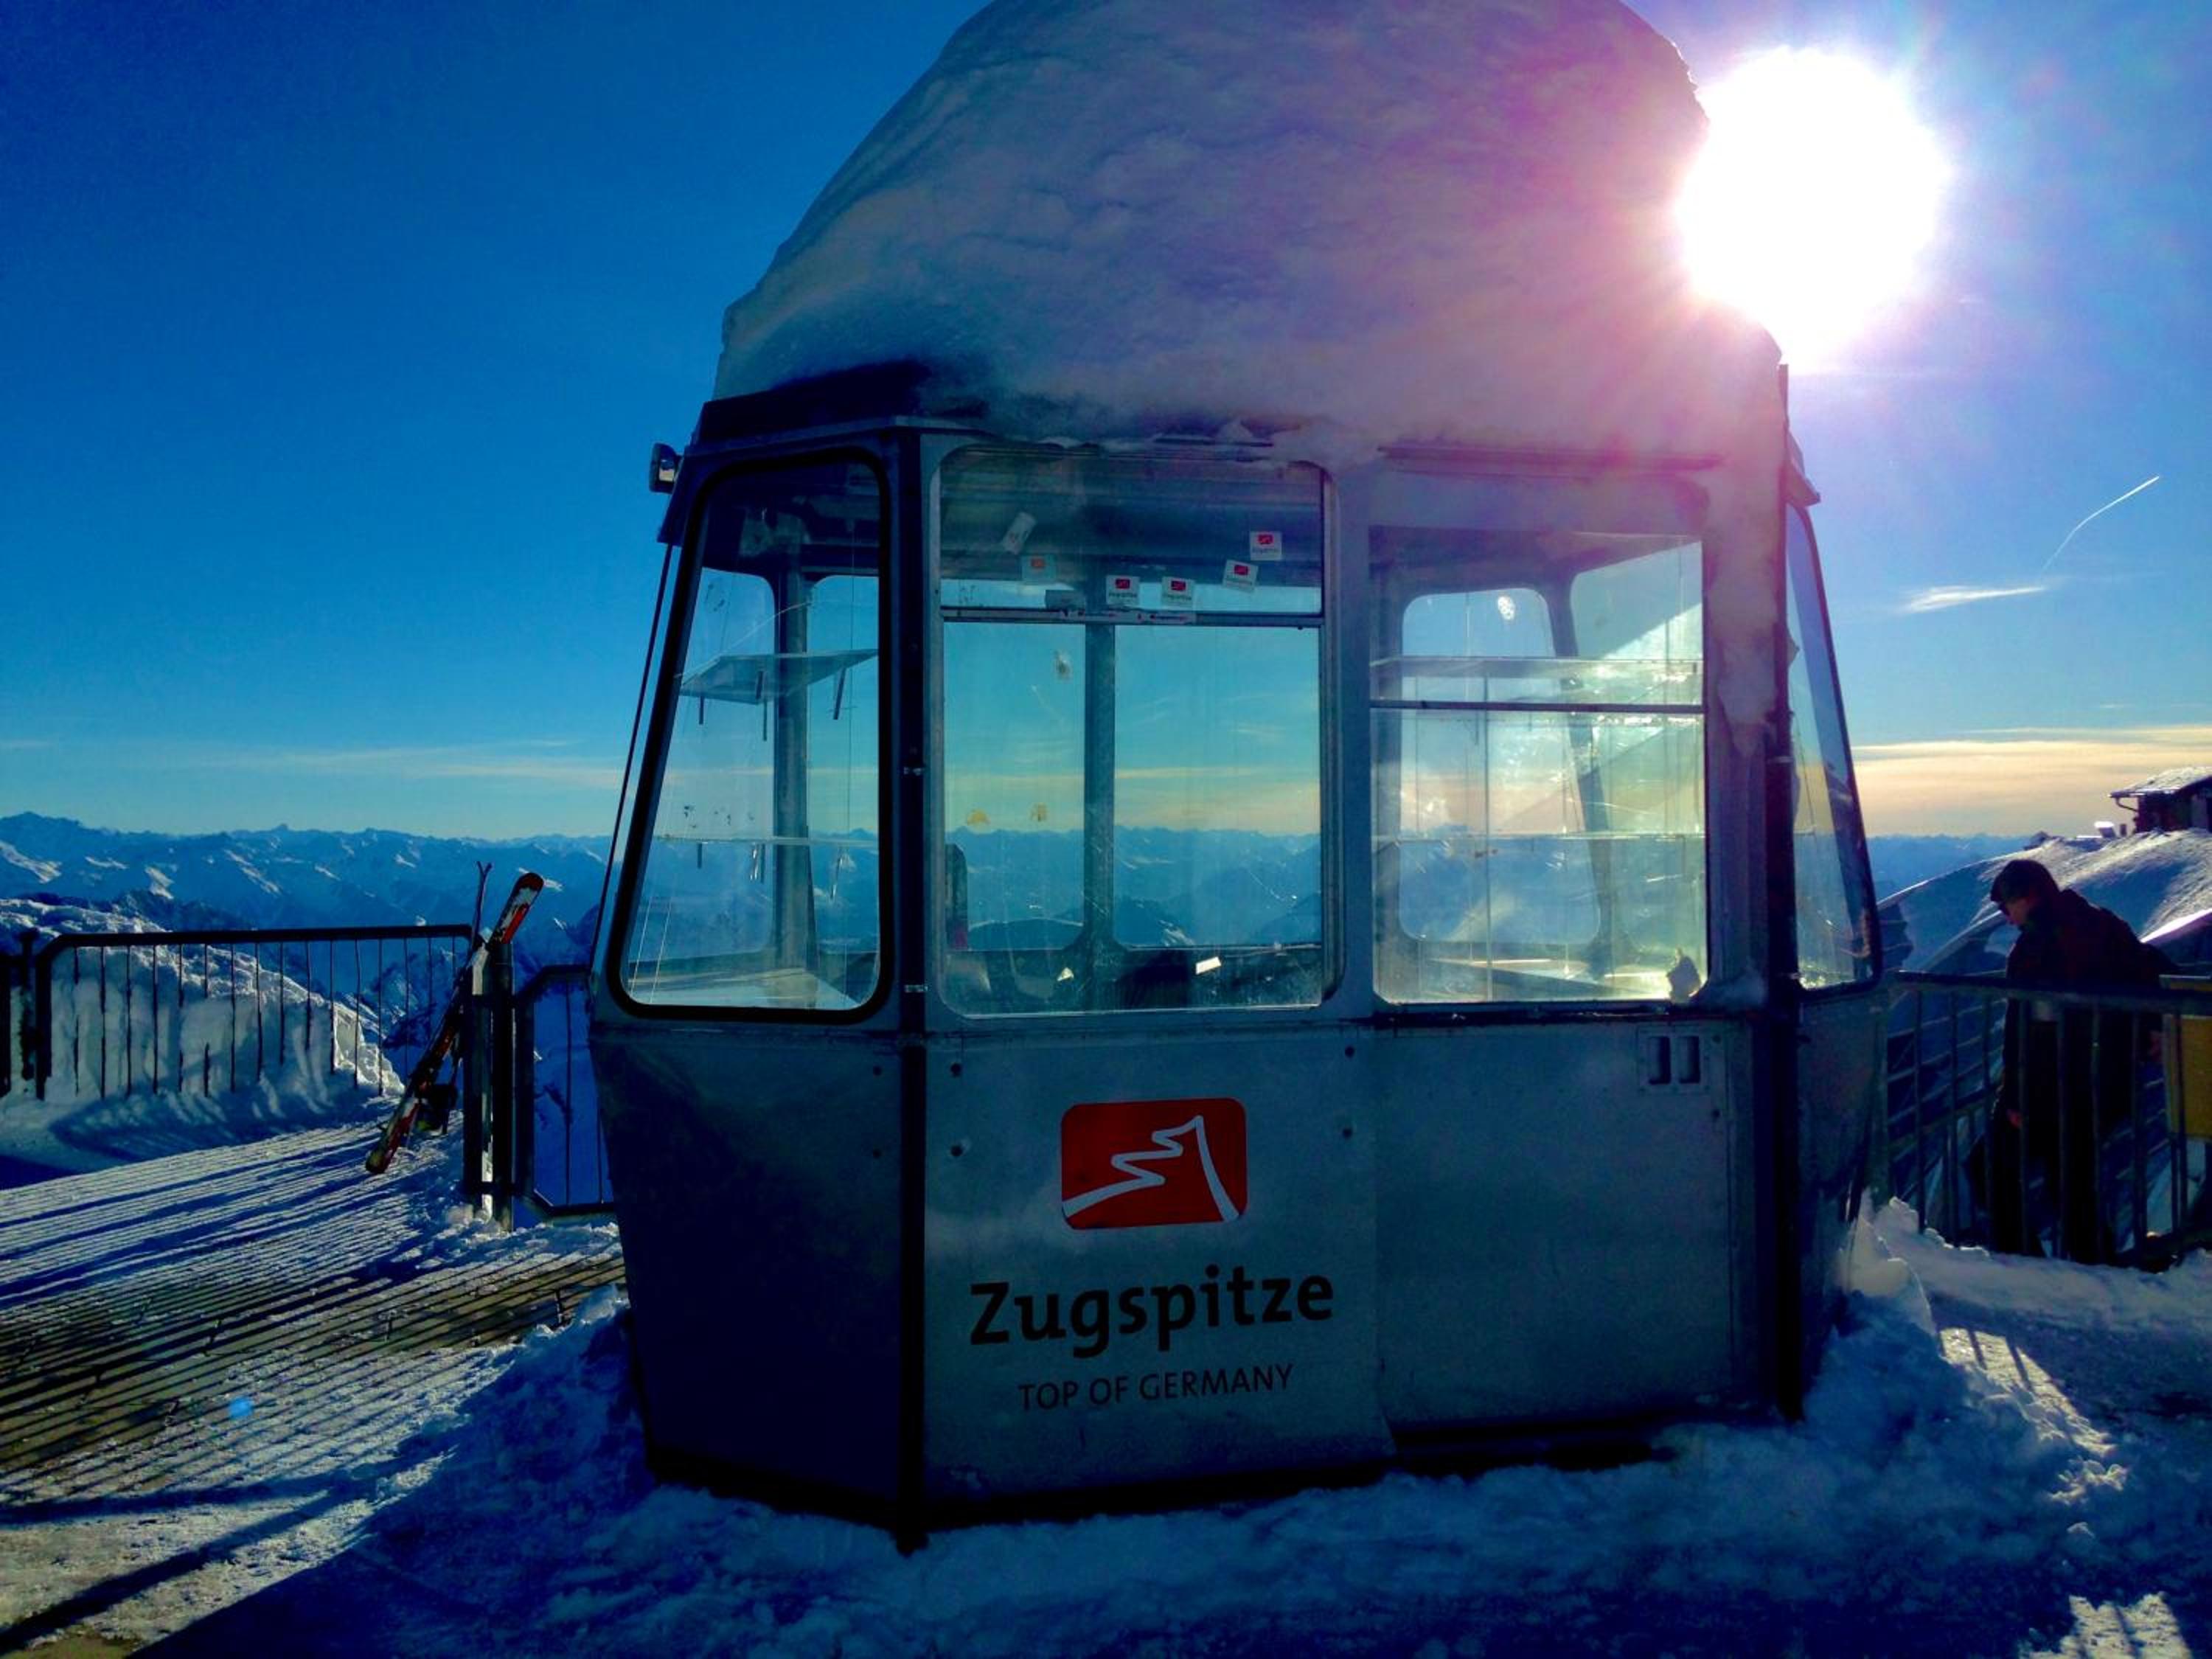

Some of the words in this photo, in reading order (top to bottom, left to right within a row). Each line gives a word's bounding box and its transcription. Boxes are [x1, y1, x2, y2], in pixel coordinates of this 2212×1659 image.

[970, 1265, 1334, 1359] Zugspitze
[1018, 1380, 1078, 1411] TOP
[1089, 1377, 1129, 1406] OF
[1139, 1364, 1295, 1401] GERMANY
